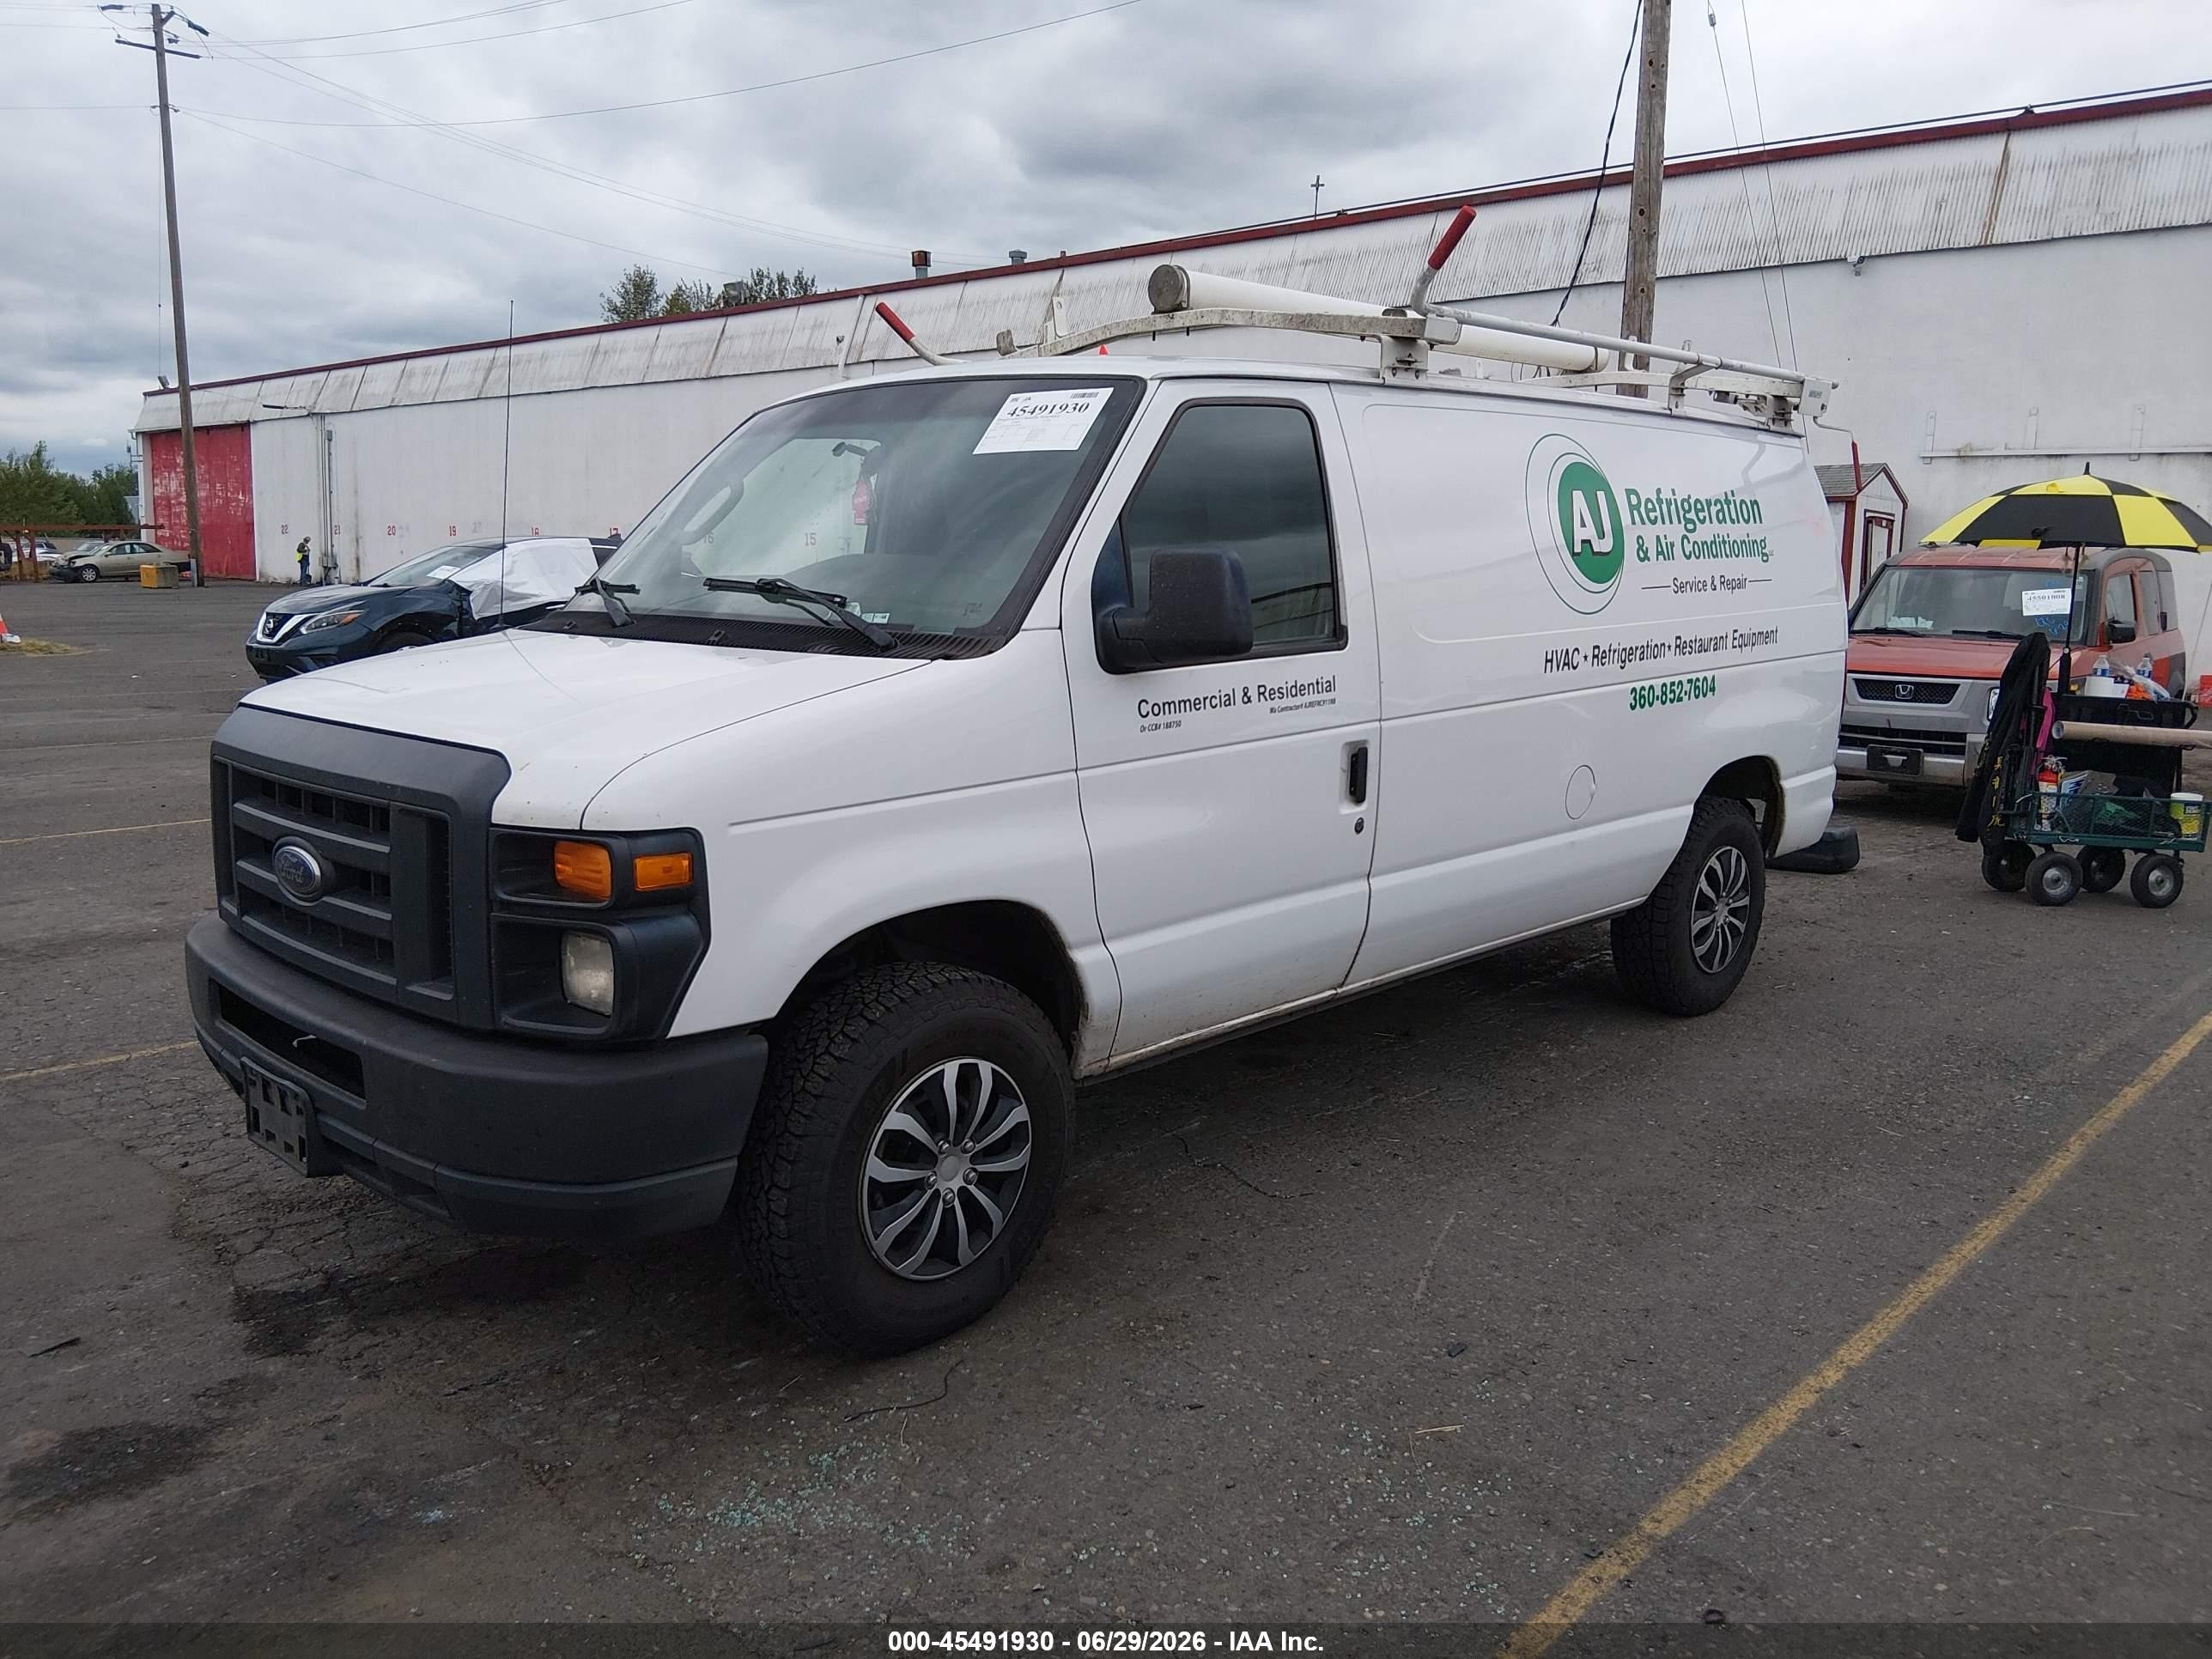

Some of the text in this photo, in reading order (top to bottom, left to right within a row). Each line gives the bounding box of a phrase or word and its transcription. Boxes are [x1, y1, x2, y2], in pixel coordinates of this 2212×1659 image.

[1006, 402, 1091, 418] 45491930
[1624, 487, 1763, 533] Refrigeration
[281, 524, 289, 534] 22
[334, 525, 341, 535] 21
[386, 525, 396, 536] 20
[448, 526, 457, 537] 19
[1571, 489, 1614, 557] AJ
[805, 532, 817, 546] 15
[1636, 534, 1651, 563] &
[1656, 534, 1675, 562] Air
[1680, 532, 1769, 563] Conditioning
[1673, 574, 1748, 594] Service & Repair
[1544, 626, 1779, 674] HVAC Refrigeration Restaurant Equipment
[1137, 674, 1337, 719] Commercial & Residential
[1629, 674, 1717, 711] 360-852-7604
